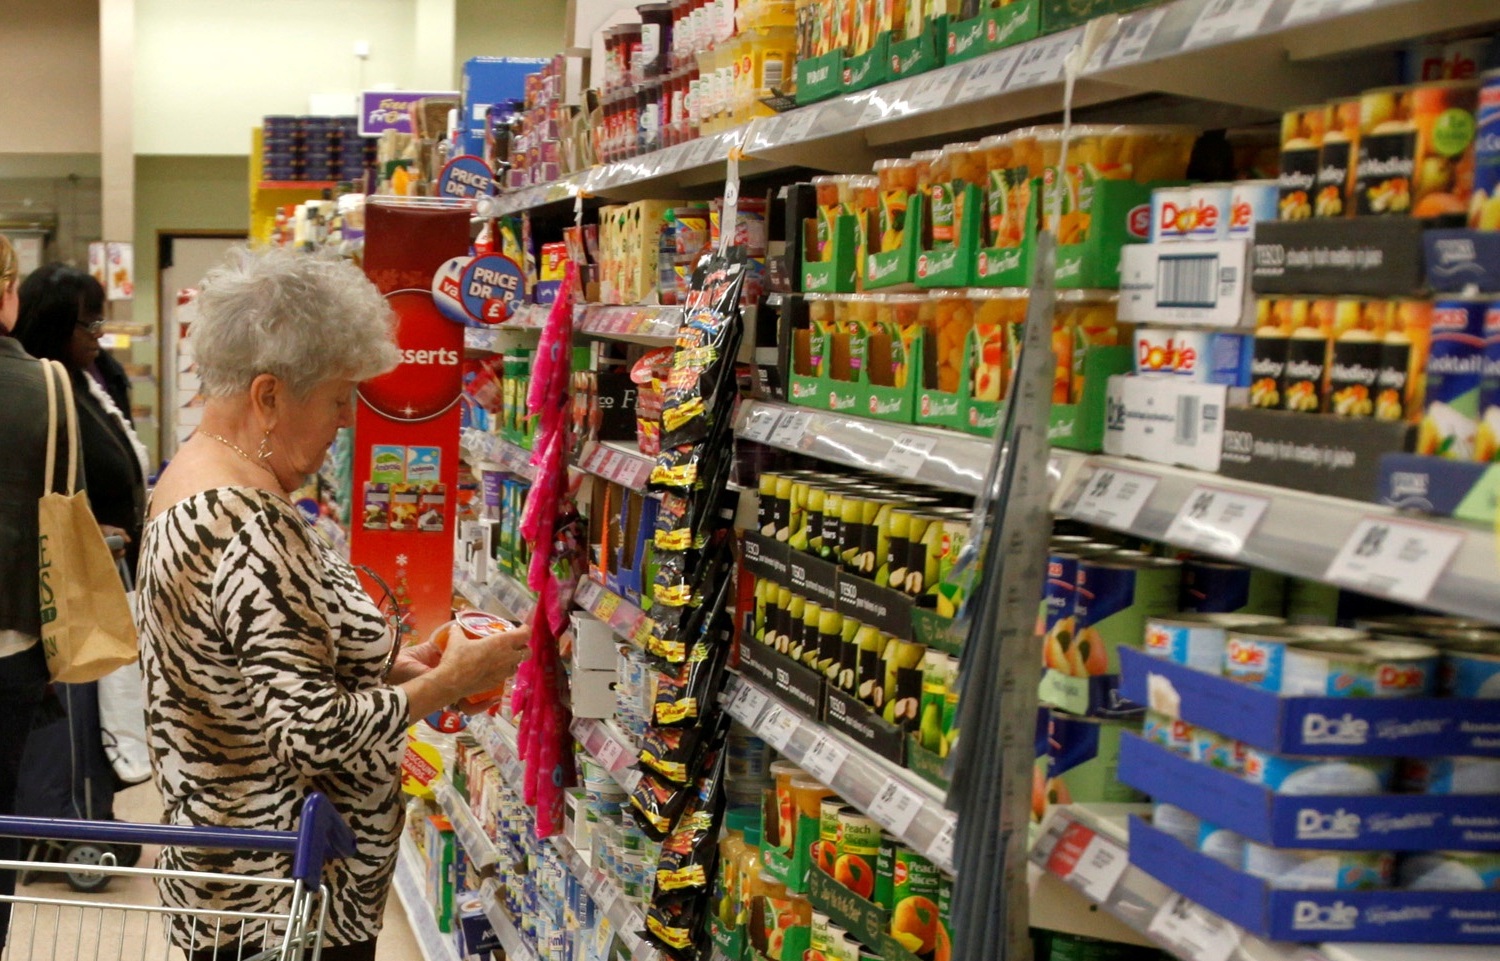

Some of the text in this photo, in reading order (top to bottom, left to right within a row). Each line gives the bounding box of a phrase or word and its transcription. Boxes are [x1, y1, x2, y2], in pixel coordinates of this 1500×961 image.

[450, 166, 490, 190] PRICE
[473, 266, 519, 292] PRICE
[488, 303, 501, 319] £
[397, 346, 459, 365] sserts
[791, 564, 806, 581] TESCO
[839, 581, 857, 599] TESCO
[829, 695, 847, 716] TESCO
[1304, 713, 1370, 740] Dole
[844, 822, 872, 835] Peach
[1297, 807, 1362, 835] Dole
[909, 873, 939, 886] Slices
[1294, 900, 1359, 928] Dole
